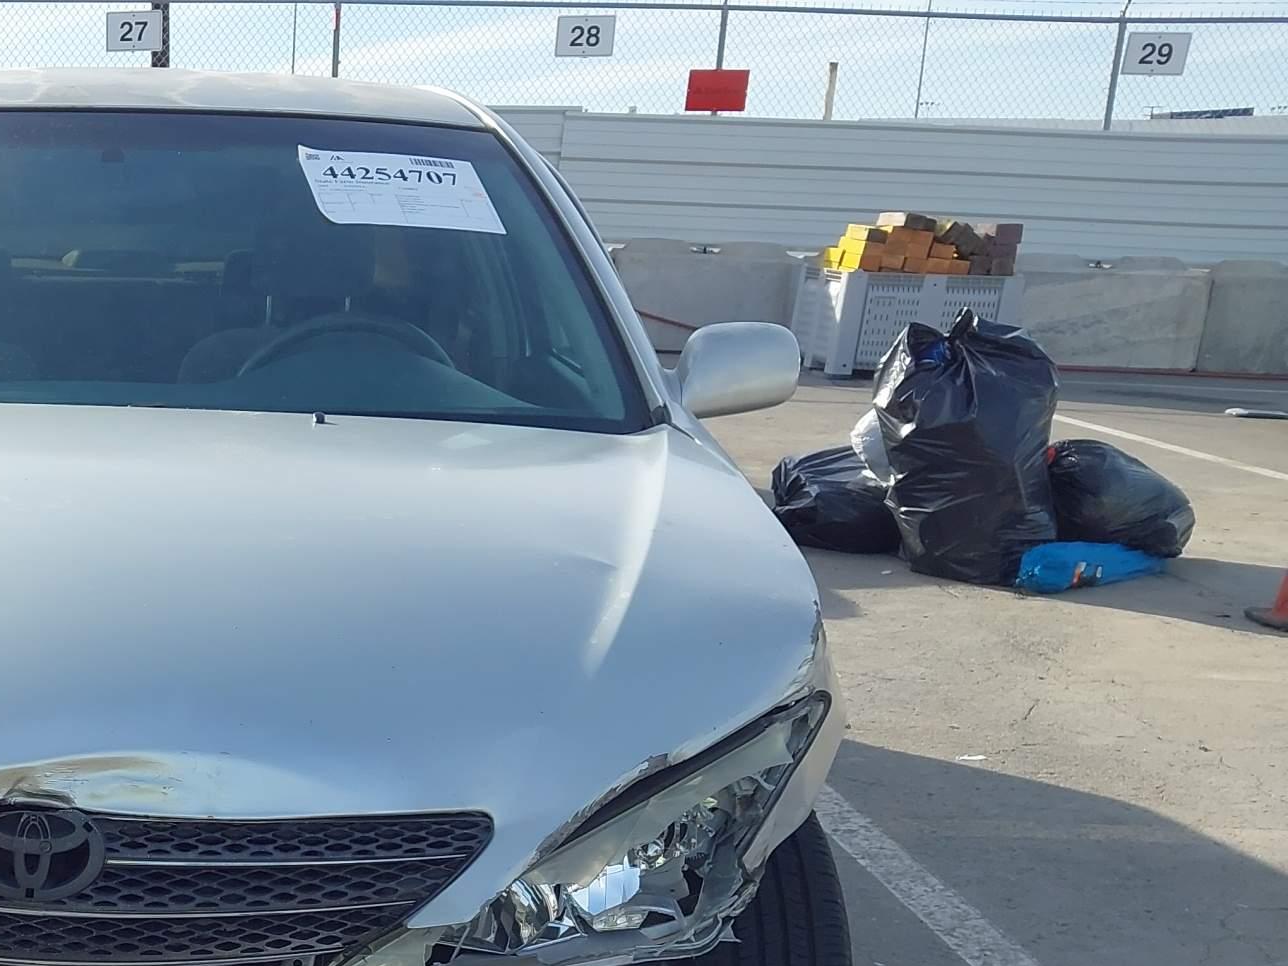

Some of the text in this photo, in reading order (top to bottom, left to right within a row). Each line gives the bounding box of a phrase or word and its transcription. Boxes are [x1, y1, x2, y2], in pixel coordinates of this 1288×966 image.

[119, 21, 149, 43] 27
[568, 24, 601, 48] 28
[1137, 42, 1174, 66] 29
[322, 165, 457, 186] 44254707
